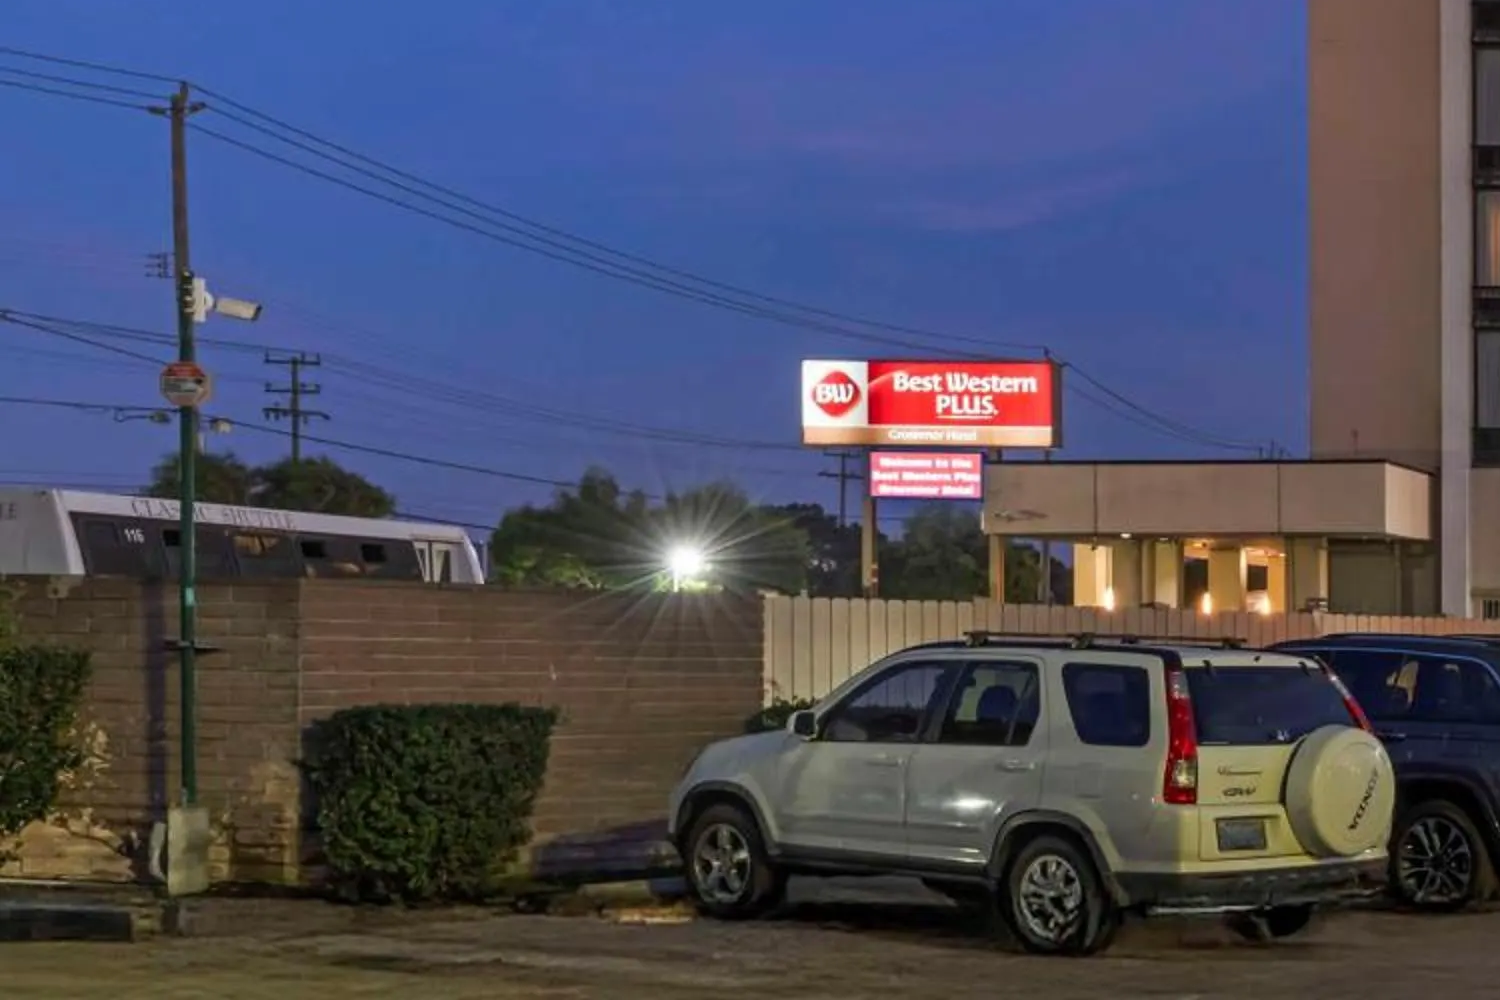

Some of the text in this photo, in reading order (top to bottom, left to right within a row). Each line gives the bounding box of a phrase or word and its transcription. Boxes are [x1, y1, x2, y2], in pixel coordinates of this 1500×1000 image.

[815, 383, 854, 404] BW
[892, 371, 1038, 394] Best Western
[936, 395, 993, 415] PLUS
[131, 499, 207, 522] CLASIC
